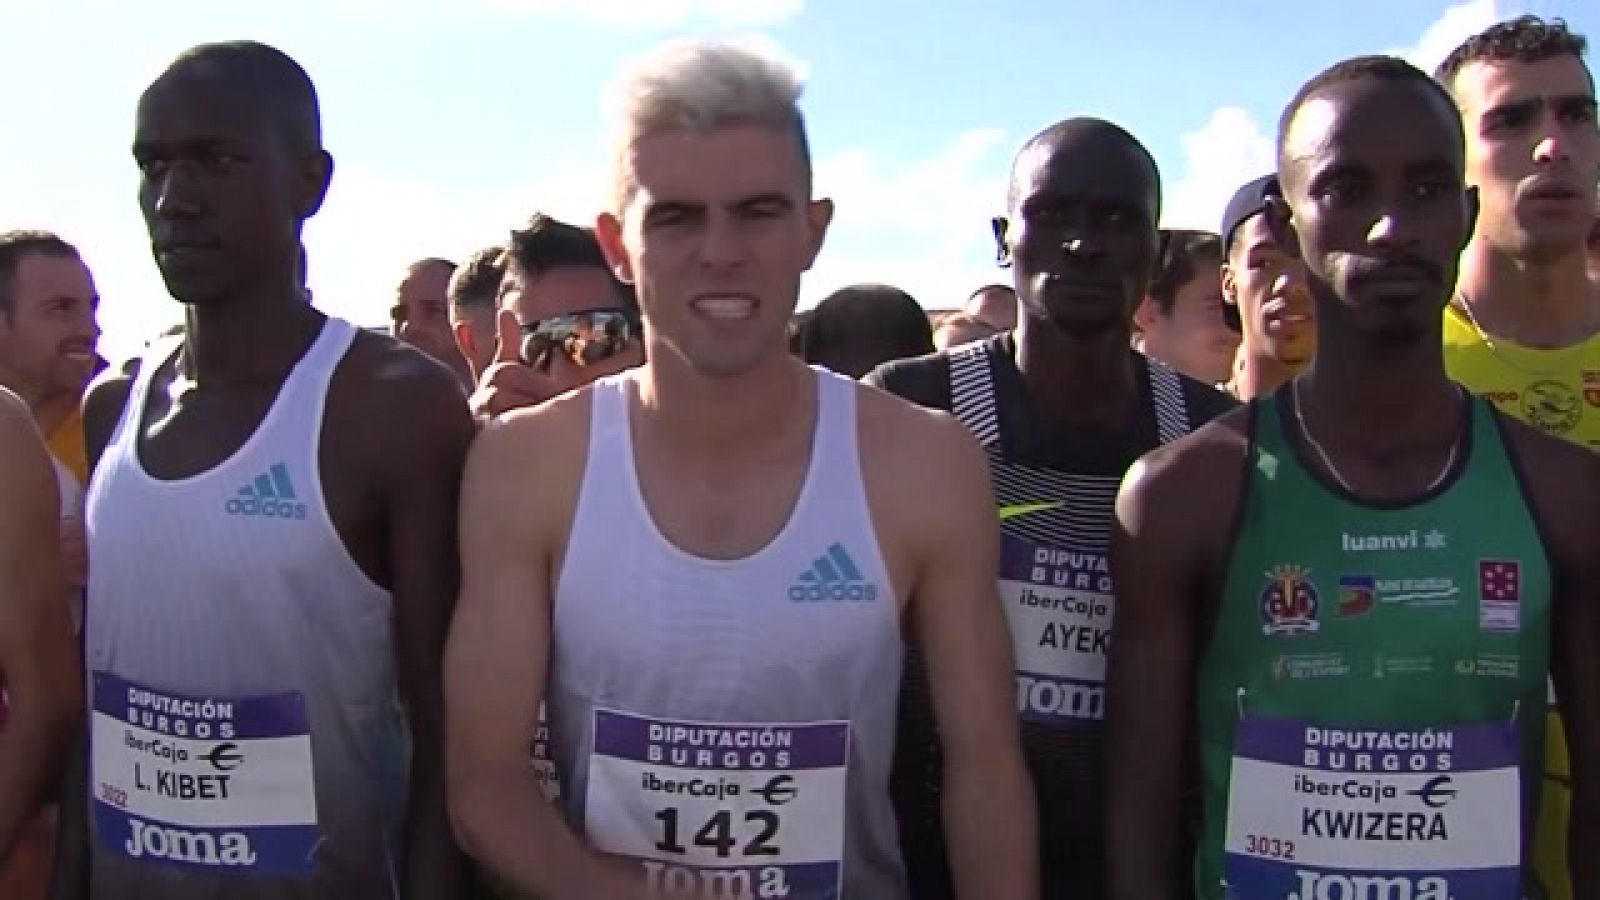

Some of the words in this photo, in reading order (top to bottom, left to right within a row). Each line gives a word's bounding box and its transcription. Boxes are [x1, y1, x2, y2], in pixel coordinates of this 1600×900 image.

[225, 494, 306, 521] adidas
[1342, 529, 1418, 551] luanvi
[787, 579, 877, 602] adidas
[128, 687, 233, 720] DIPUTACIÓN
[127, 706, 235, 739] BURGOS
[649, 723, 792, 747] DIPUTACIÓN
[1304, 726, 1453, 750] DIPUTACIÓN
[648, 744, 791, 768] BURGOS
[1304, 748, 1451, 771] BURGOS
[135, 762, 151, 791] L.
[157, 769, 230, 798] KIBET
[642, 772, 740, 801] iberCaja
[1294, 775, 1396, 803] iberCaja
[655, 806, 781, 858] 142
[1302, 807, 1448, 841] KWIZERA
[1246, 834, 1295, 860] 3032
